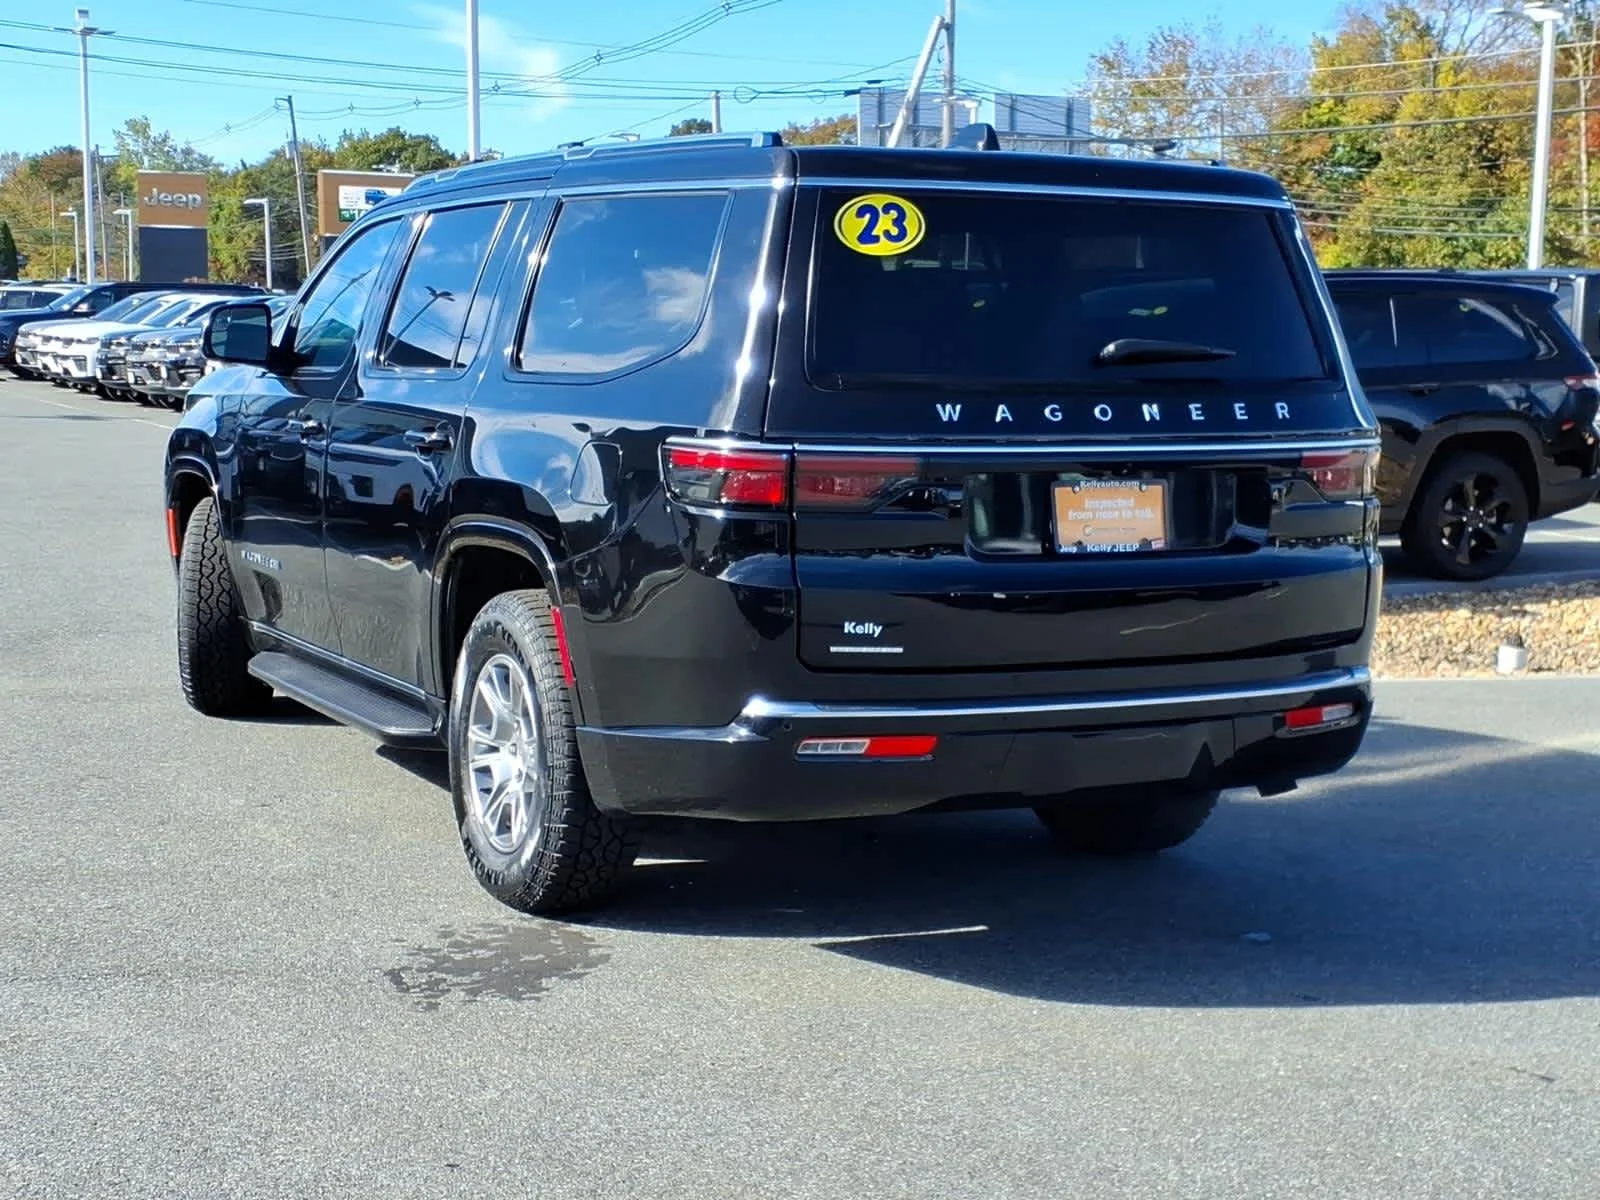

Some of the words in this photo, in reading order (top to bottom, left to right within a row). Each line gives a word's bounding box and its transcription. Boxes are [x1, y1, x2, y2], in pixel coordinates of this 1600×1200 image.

[143, 187, 202, 210] Jeep
[856, 202, 908, 245] 23
[935, 402, 1291, 423] WAGONEER
[844, 621, 883, 638] Kelly
